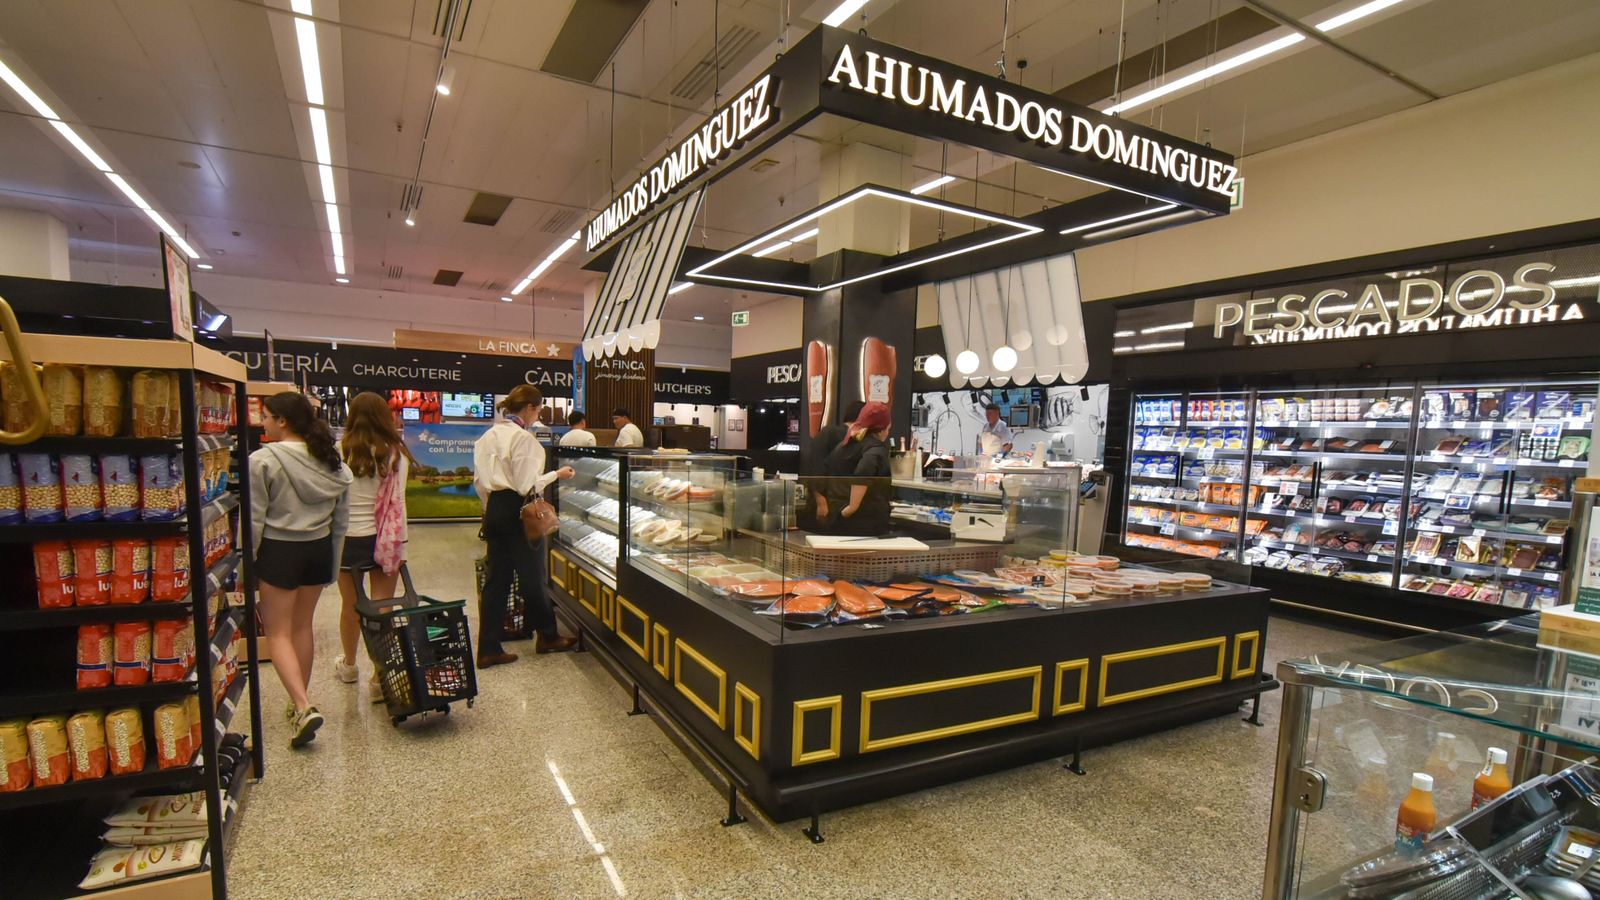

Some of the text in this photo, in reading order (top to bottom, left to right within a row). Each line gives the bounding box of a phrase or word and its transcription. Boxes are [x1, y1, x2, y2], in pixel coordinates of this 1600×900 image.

[827, 43, 1238, 198] AHUMADOS DOMINGUEZ
[586, 74, 771, 252] AHUMADOS DOMINGUEZ
[1213, 262, 1557, 339] PESCADOS
[478, 340, 538, 354] LA FINCA
[594, 359, 646, 371] LA FINCA
[352, 363, 462, 381] CHARCUTERIE
